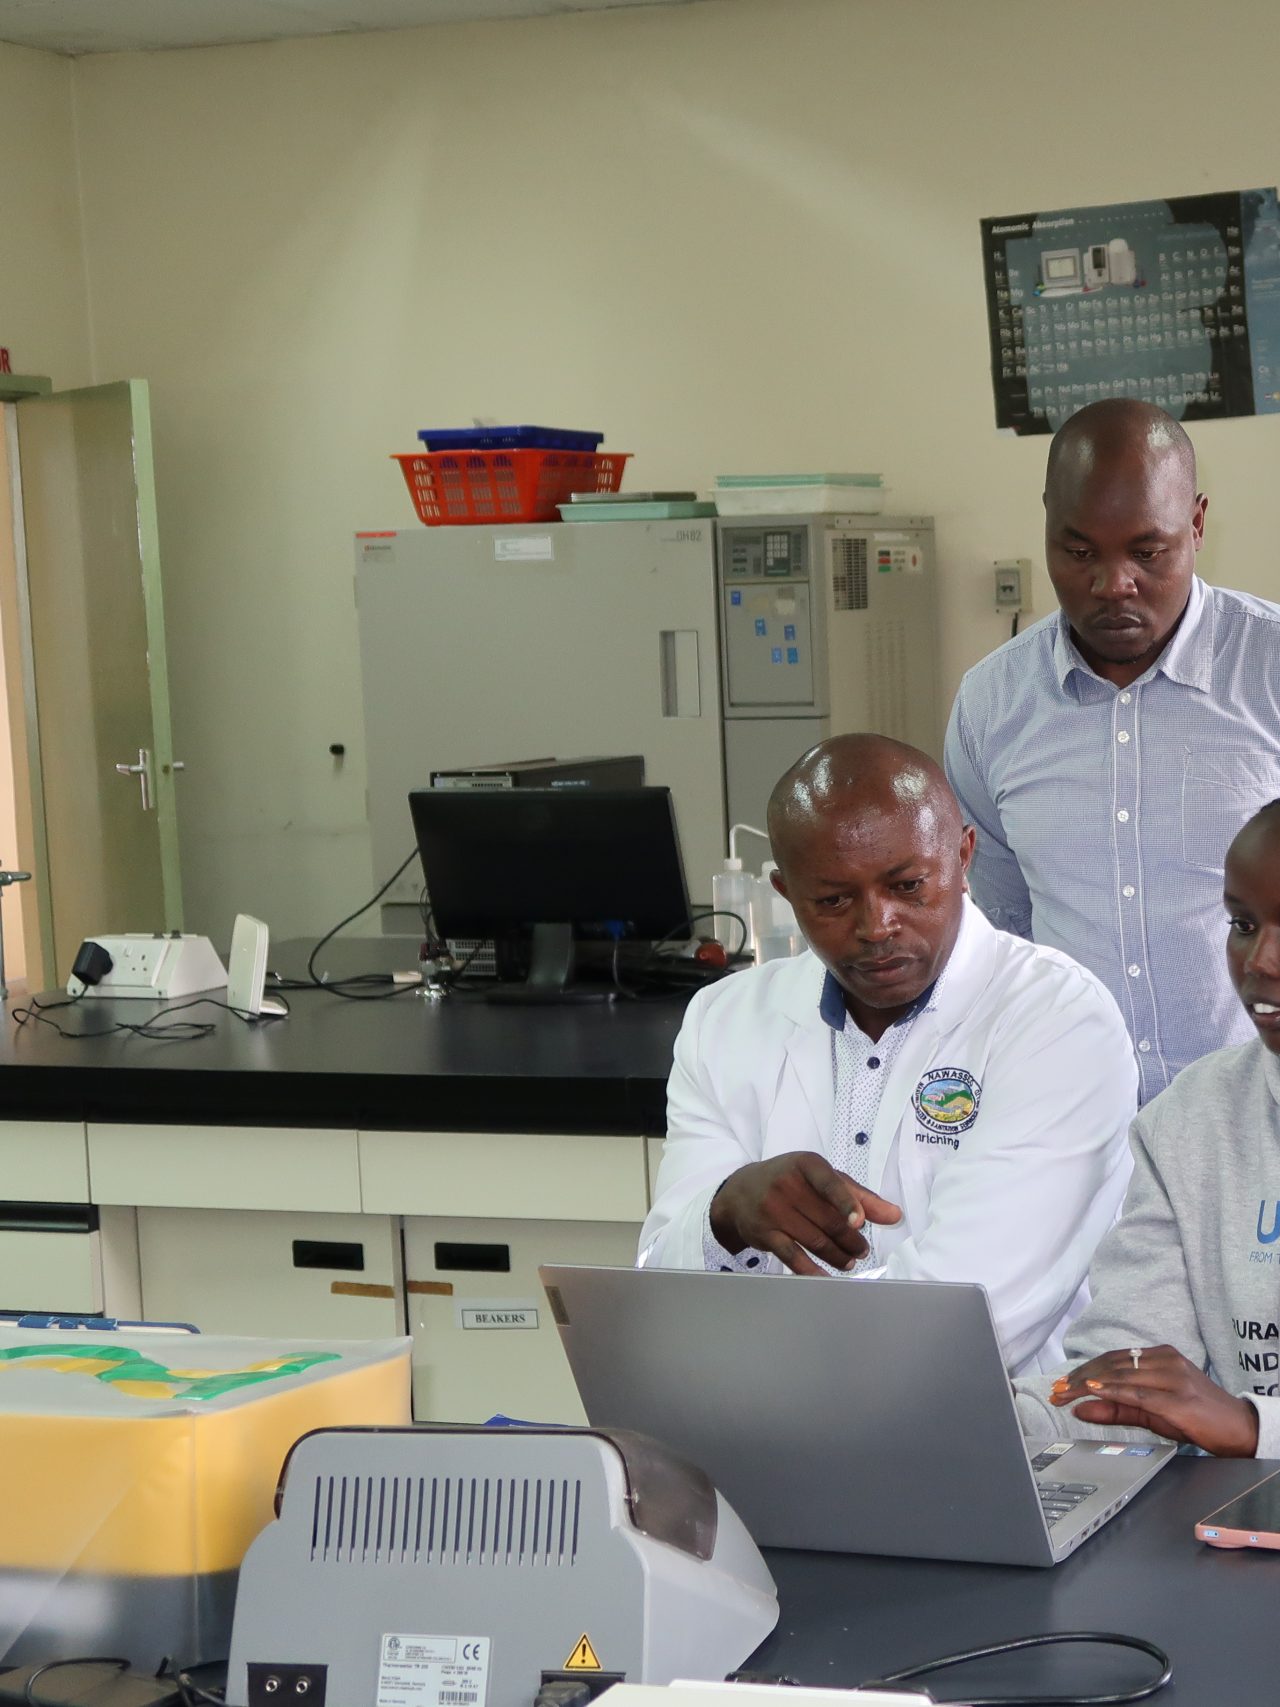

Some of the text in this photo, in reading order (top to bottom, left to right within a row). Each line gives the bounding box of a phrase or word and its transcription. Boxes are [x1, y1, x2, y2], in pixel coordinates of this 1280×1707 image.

[916, 1133, 960, 1150] nriching
[1249, 1251, 1273, 1263] FROM
[475, 1314, 526, 1324] BEAKERS
[1238, 1350, 1280, 1372] AND
[462, 1643, 480, 1660] CE
